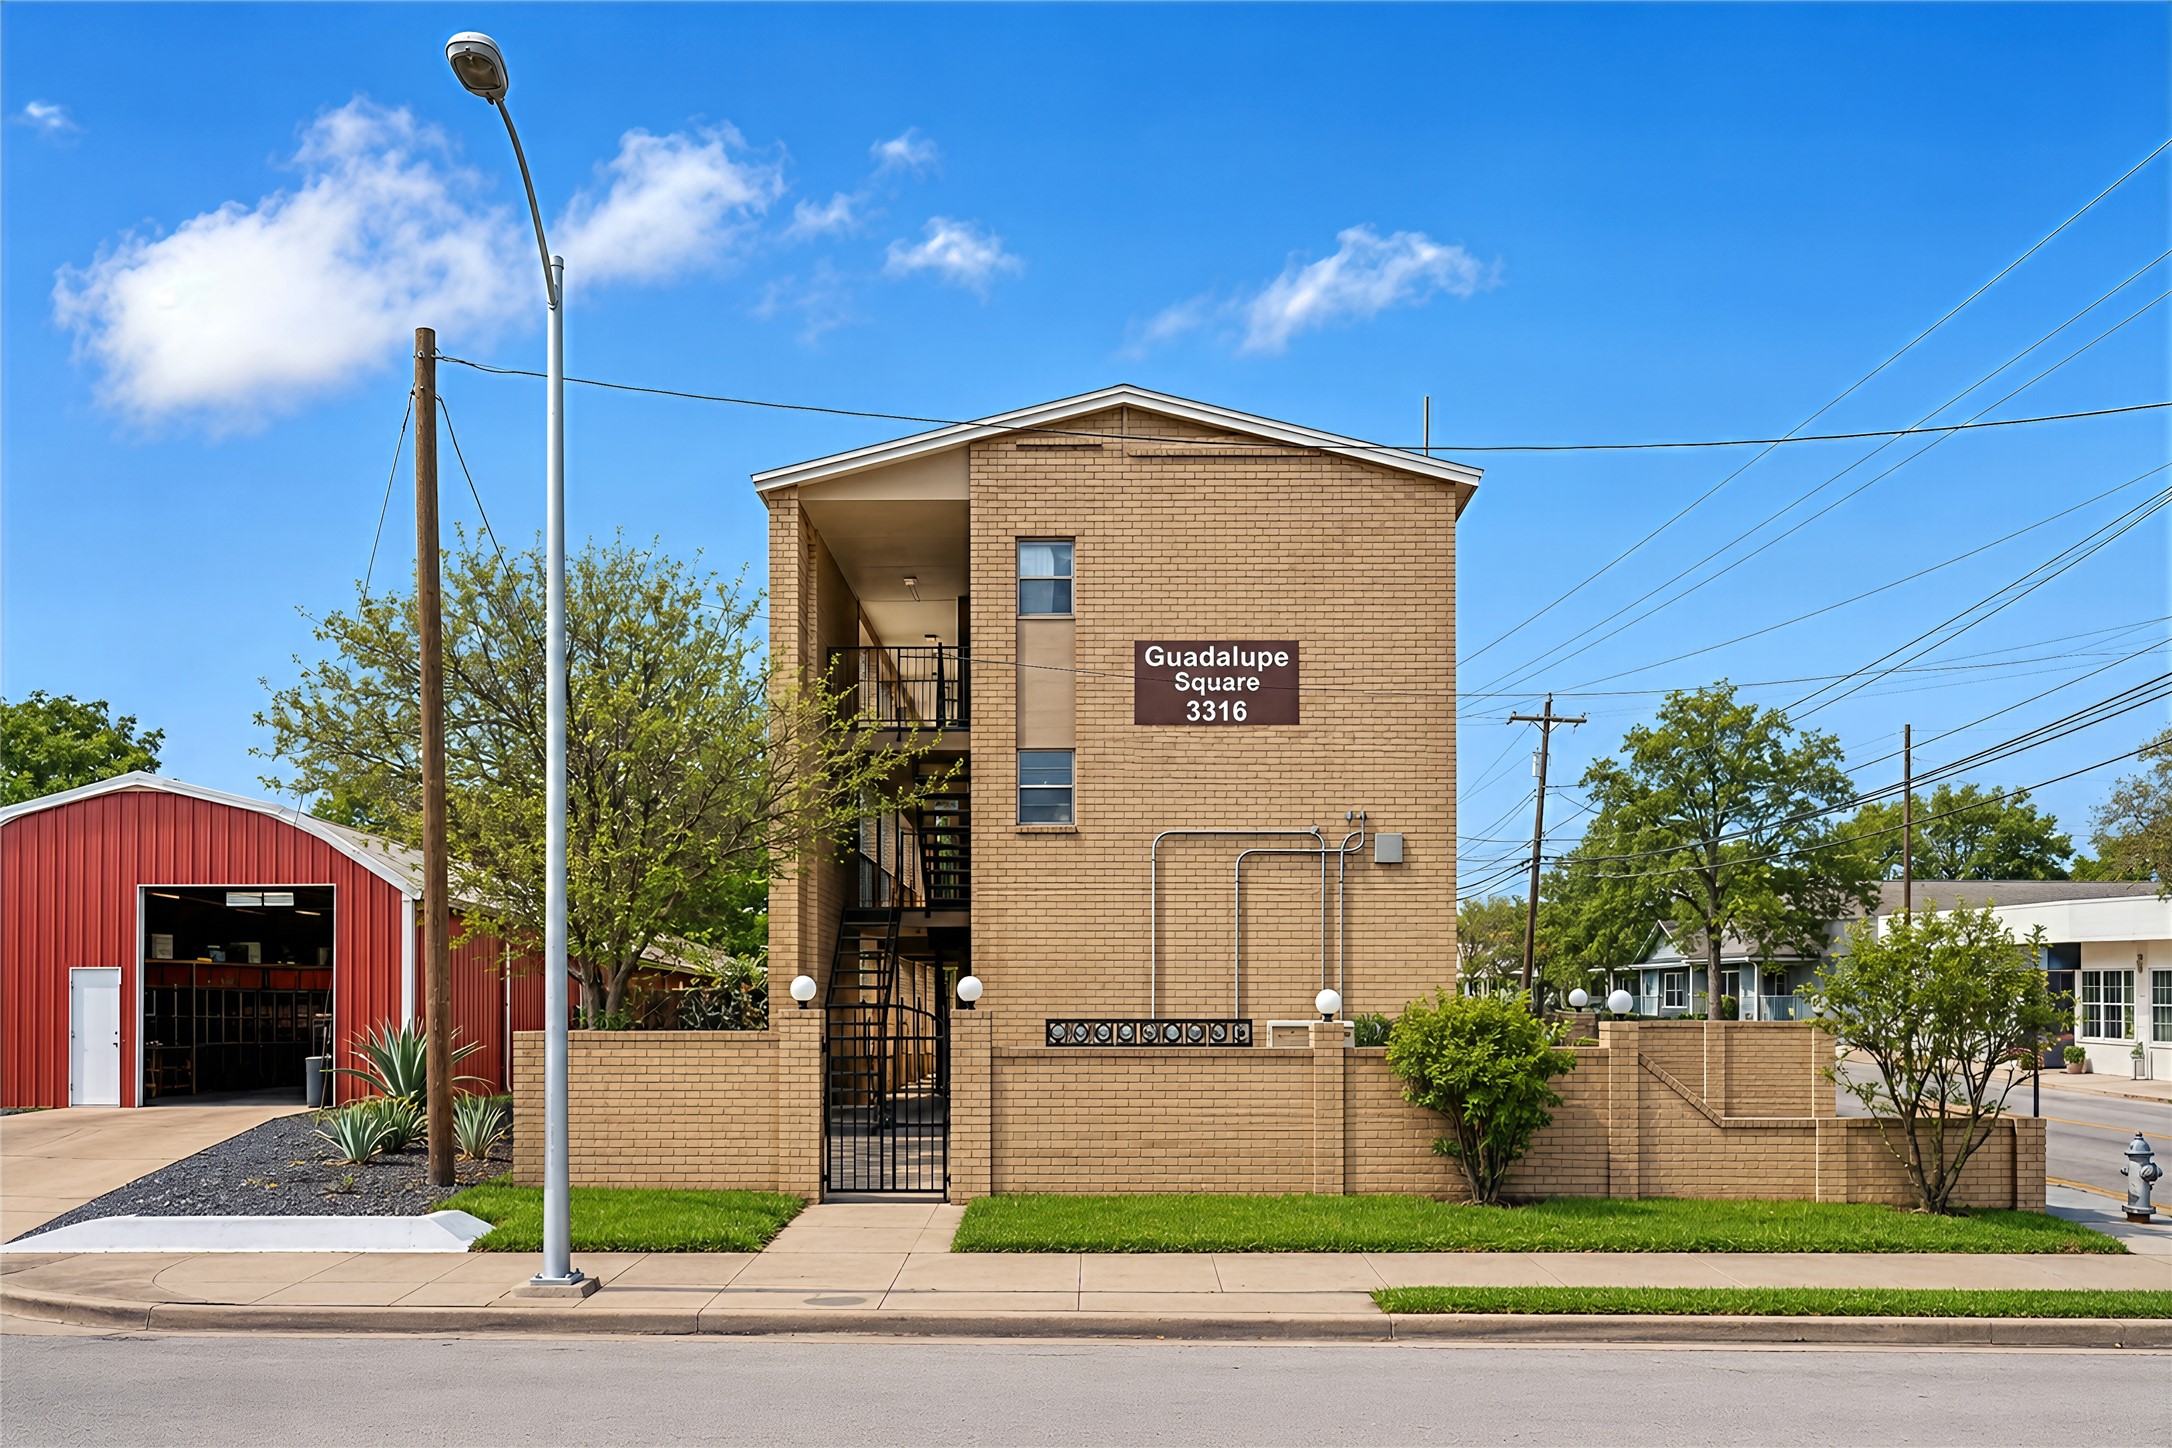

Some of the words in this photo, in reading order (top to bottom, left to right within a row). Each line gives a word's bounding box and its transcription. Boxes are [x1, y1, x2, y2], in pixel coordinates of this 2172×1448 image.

[1144, 645, 1289, 672] Guadalupe
[1174, 671, 1260, 696] Square
[1186, 700, 1248, 722] 3316
